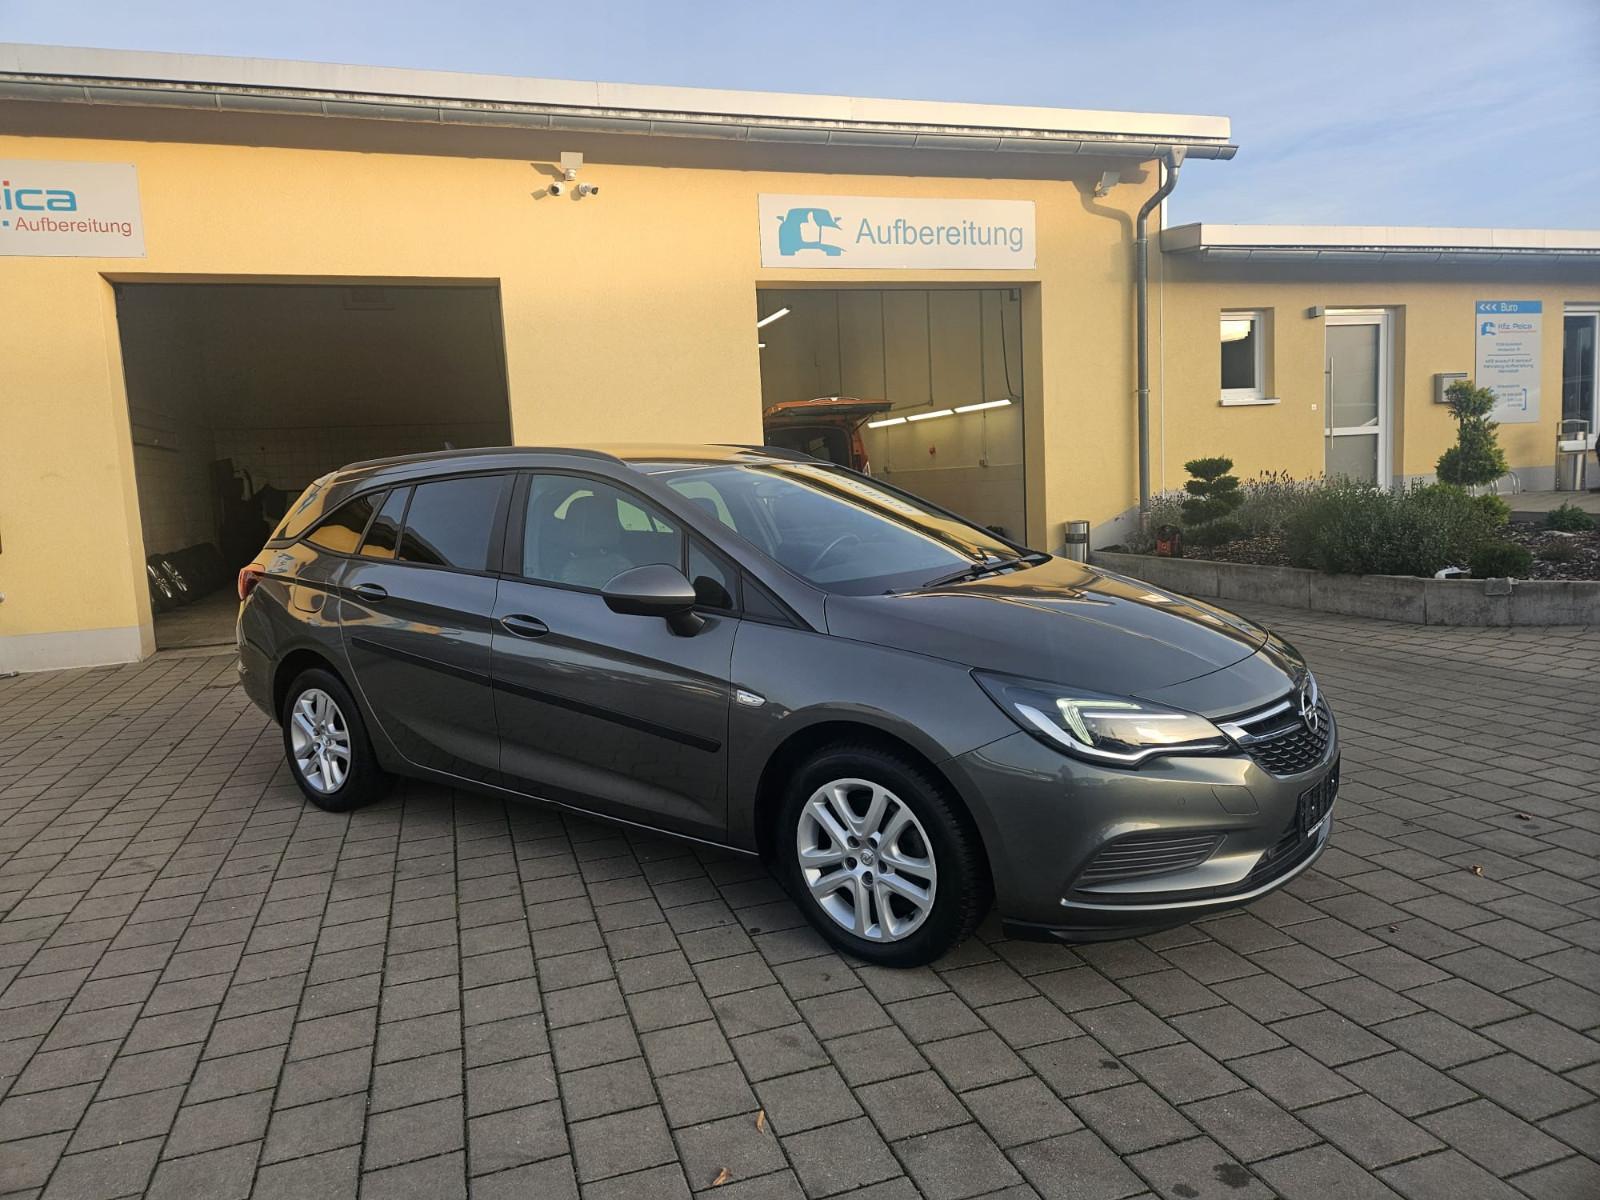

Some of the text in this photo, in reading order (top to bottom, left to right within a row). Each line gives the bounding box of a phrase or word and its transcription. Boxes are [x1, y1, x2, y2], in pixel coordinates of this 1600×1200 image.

[0, 180, 77, 212] ica
[15, 217, 132, 237] Aufbereitung
[855, 218, 1024, 252] Aufbereitung
